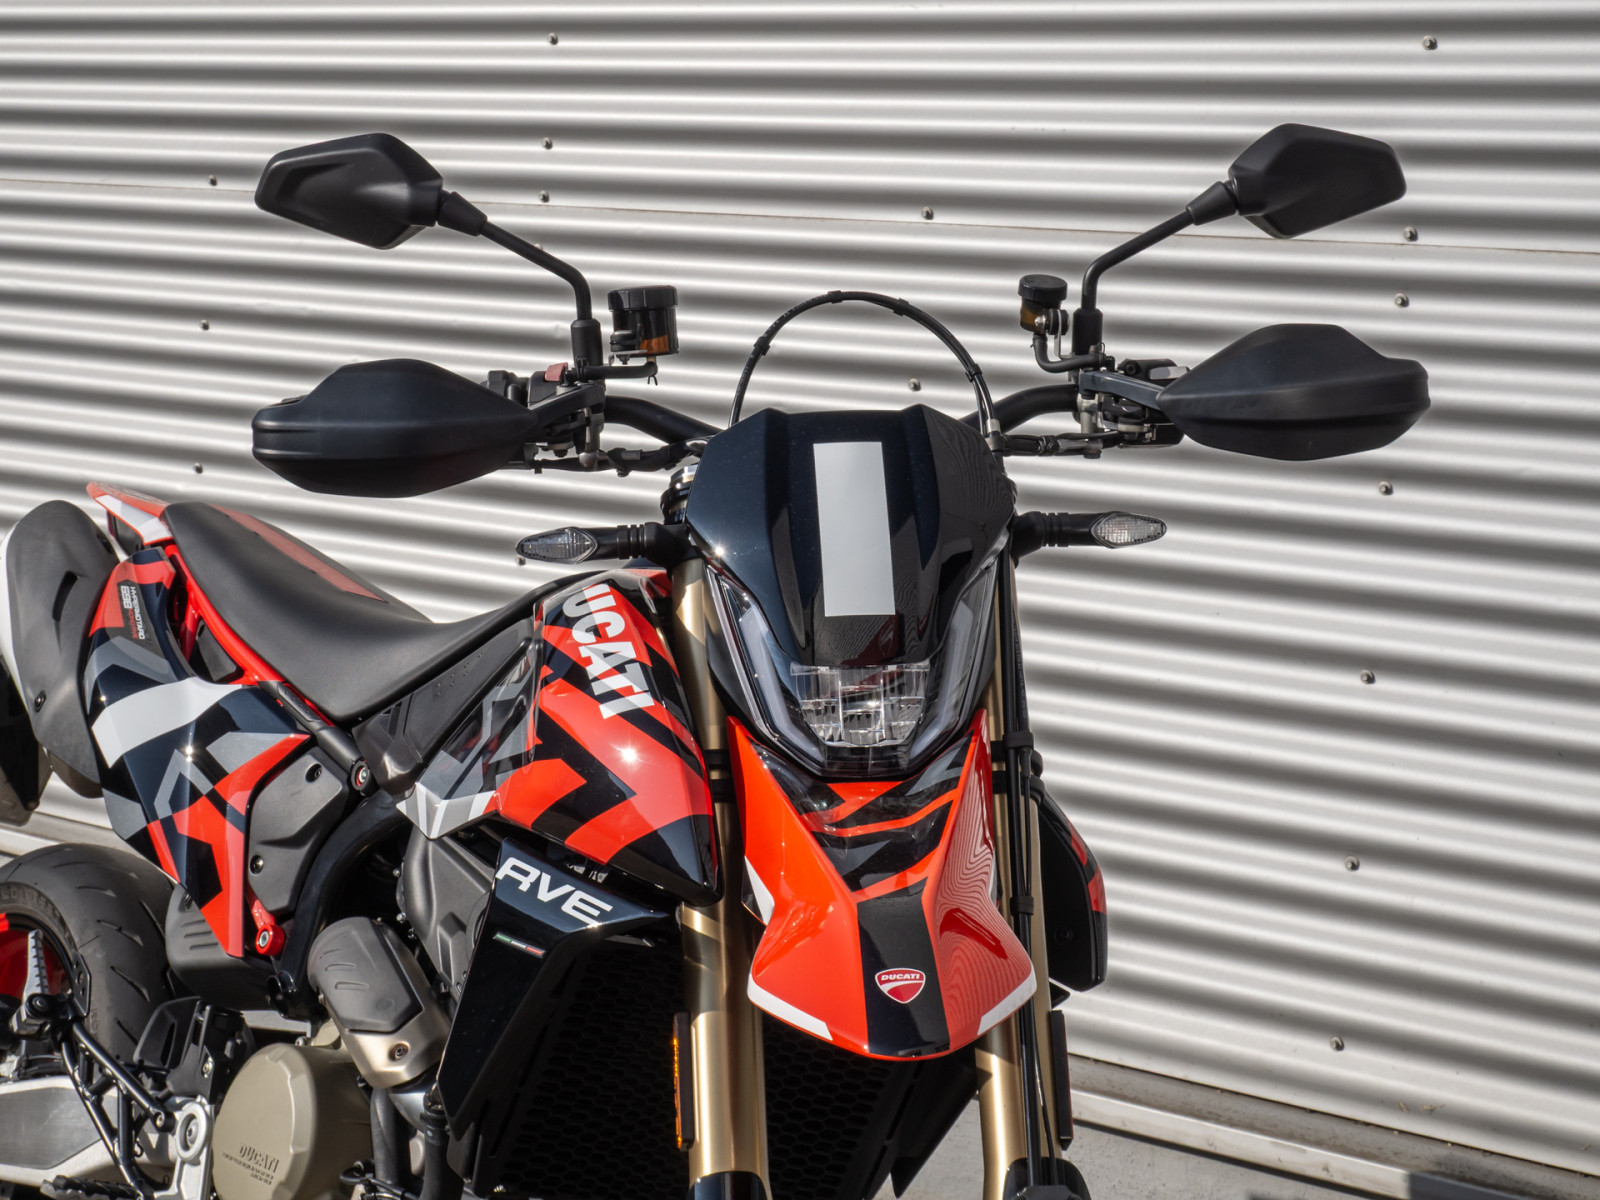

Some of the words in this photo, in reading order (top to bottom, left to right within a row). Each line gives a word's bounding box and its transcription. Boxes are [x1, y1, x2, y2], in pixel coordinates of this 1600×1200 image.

[120, 585, 133, 609] 698
[130, 586, 146, 640] HYPERMOTARD
[495, 857, 614, 928] RVE
[880, 973, 921, 981] DUCATI
[239, 1144, 280, 1173] DUCATI
